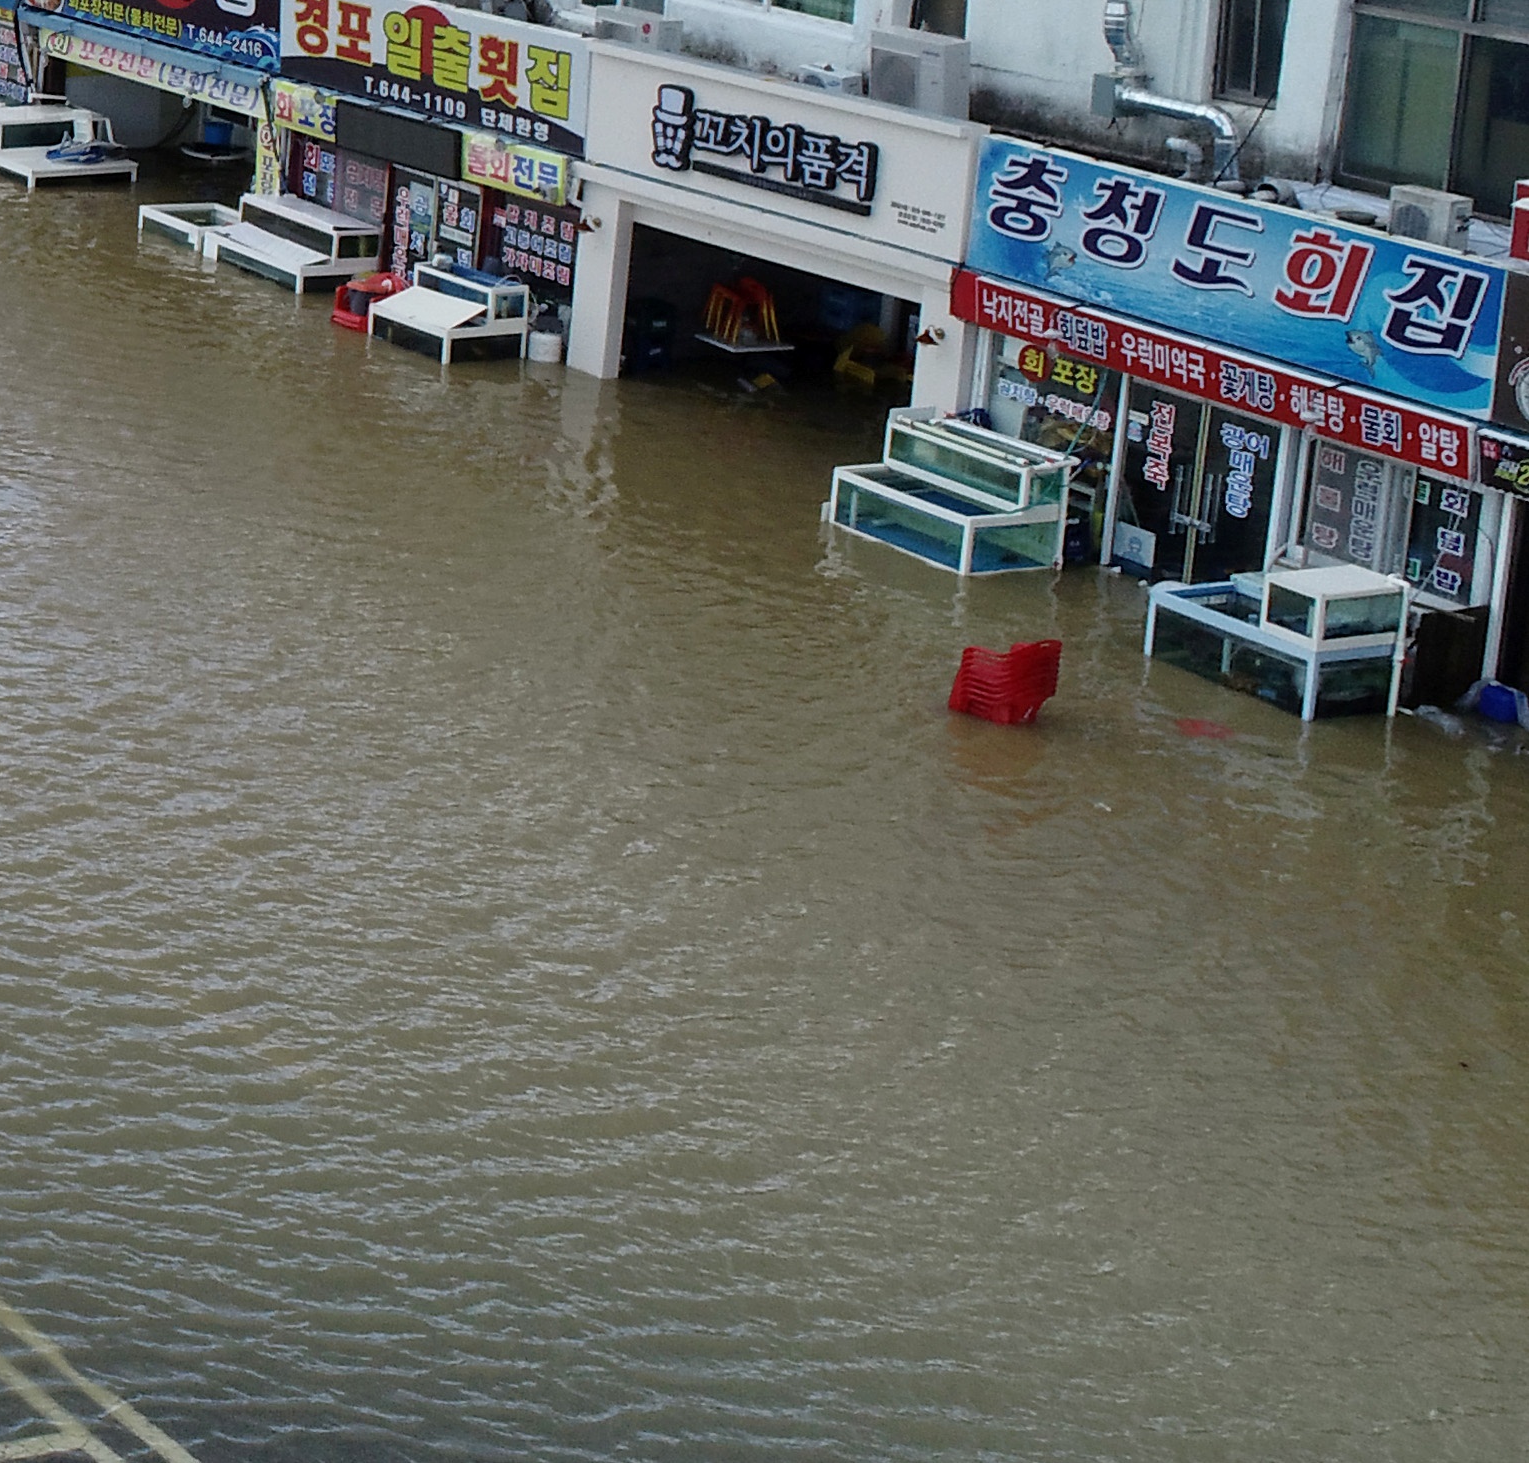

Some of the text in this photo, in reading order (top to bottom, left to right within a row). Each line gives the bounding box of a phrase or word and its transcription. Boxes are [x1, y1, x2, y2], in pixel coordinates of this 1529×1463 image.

[186, 22, 263, 59] T.644-2416
[364, 75, 467, 120] T.644-1109
[480, 107, 550, 143] 단체환영
[693, 110, 870, 199] 꼬치의품격
[987, 154, 1489, 358] 충청도회집
[983, 288, 1045, 336] 낙지전골
[1057, 310, 1108, 360] 회덮밥
[1120, 331, 1207, 390] 우럭미역국
[1219, 360, 1277, 413] 꽃게탕
[1359, 402, 1402, 452] 물회
[1418, 422, 1458, 467] 알탕
[1023, 349, 1098, 394] 회 포장
